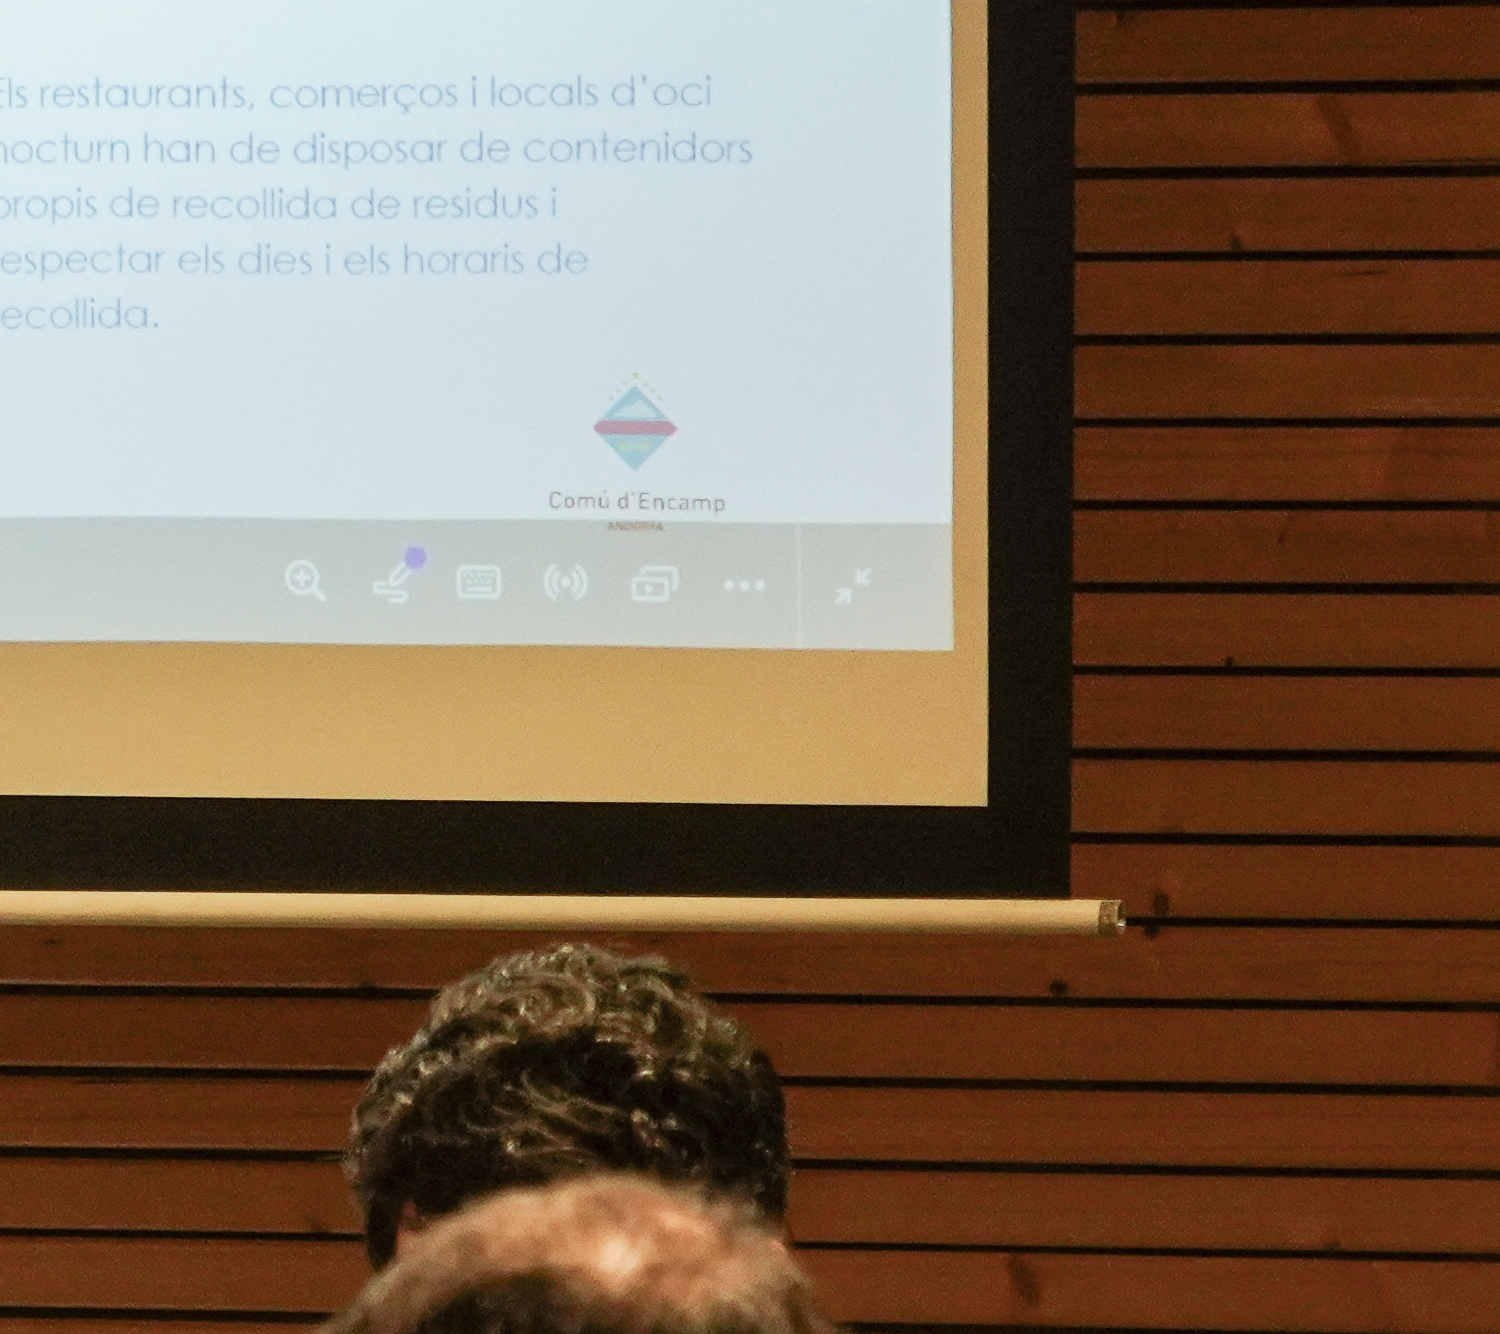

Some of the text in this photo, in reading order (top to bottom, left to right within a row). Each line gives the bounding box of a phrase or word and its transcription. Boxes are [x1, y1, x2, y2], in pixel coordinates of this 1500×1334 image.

[39, 76, 257, 113] restaurants,
[269, 83, 461, 117] comerços
[471, 75, 480, 110] i
[489, 74, 602, 110] locals
[610, 73, 715, 109] d'oci
[142, 131, 219, 166] han
[228, 132, 283, 166] de
[292, 131, 449, 172] disposar
[459, 130, 513, 165] de
[522, 130, 756, 166] contenidors
[108, 187, 163, 222] de
[172, 187, 340, 223] recollida
[349, 188, 404, 223] de
[412, 187, 541, 222] residus
[550, 187, 559, 220] i
[176, 243, 228, 277] els
[237, 242, 316, 278] dies
[325, 243, 334, 277] i
[342, 243, 393, 278] els
[402, 241, 527, 277] horaris
[536, 241, 591, 277] de
[548, 489, 727, 517] Comú d'Encamp
